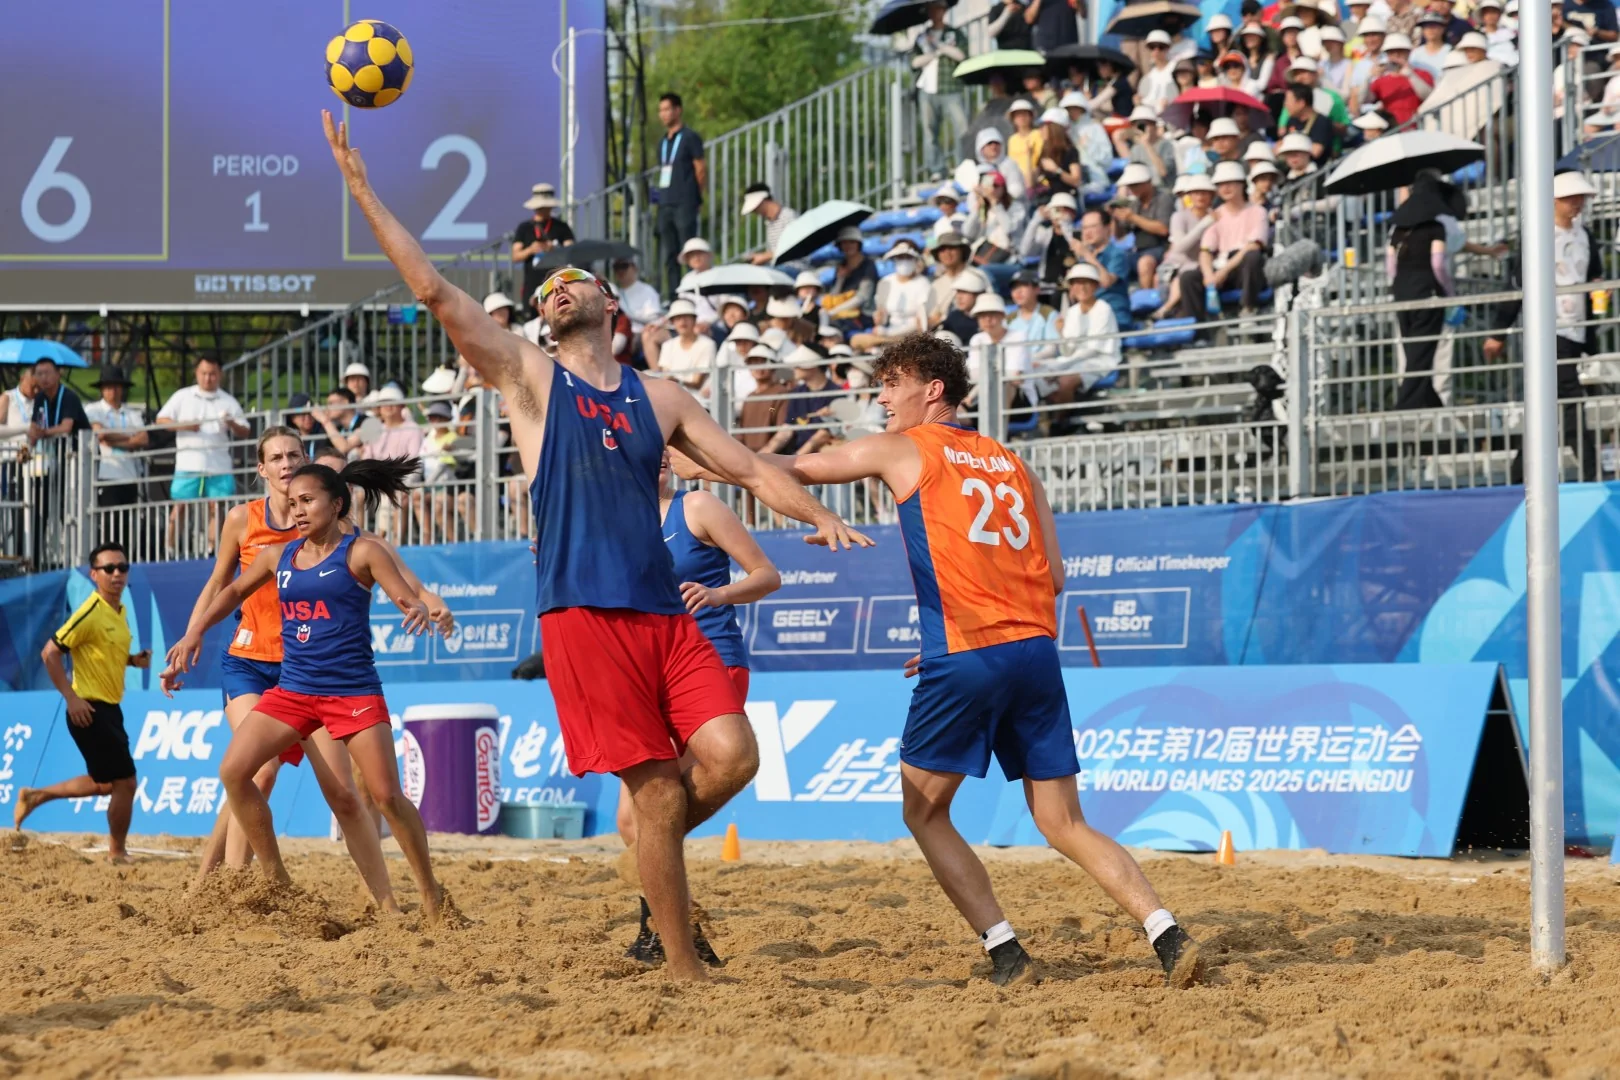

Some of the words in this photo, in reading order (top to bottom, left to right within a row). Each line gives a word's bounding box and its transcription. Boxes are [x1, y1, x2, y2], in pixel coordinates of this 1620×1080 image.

[213, 155, 299, 176] PERIOD
[21, 137, 92, 242] 6
[420, 135, 488, 241] 2
[243, 191, 269, 231] 1
[229, 275, 316, 292] TISSOT
[576, 395, 633, 433] USA
[961, 478, 1030, 550] 23
[1062, 555, 1113, 577] 计时器
[1115, 556, 1158, 572] Official
[1158, 554, 1231, 572] Timekeeper
[277, 571, 292, 588] 17
[281, 600, 331, 620] USA
[773, 608, 840, 628] GEELY
[1094, 616, 1153, 632] TISSOT
[133, 710, 224, 760] PICC
[1073, 724, 1422, 764] 025年第12届世界运动会
[1094, 769, 1169, 792] WORLD
[1169, 769, 1244, 792] GAMES
[1246, 769, 1305, 792] 2025
[1306, 769, 1414, 793] CHENGDU
